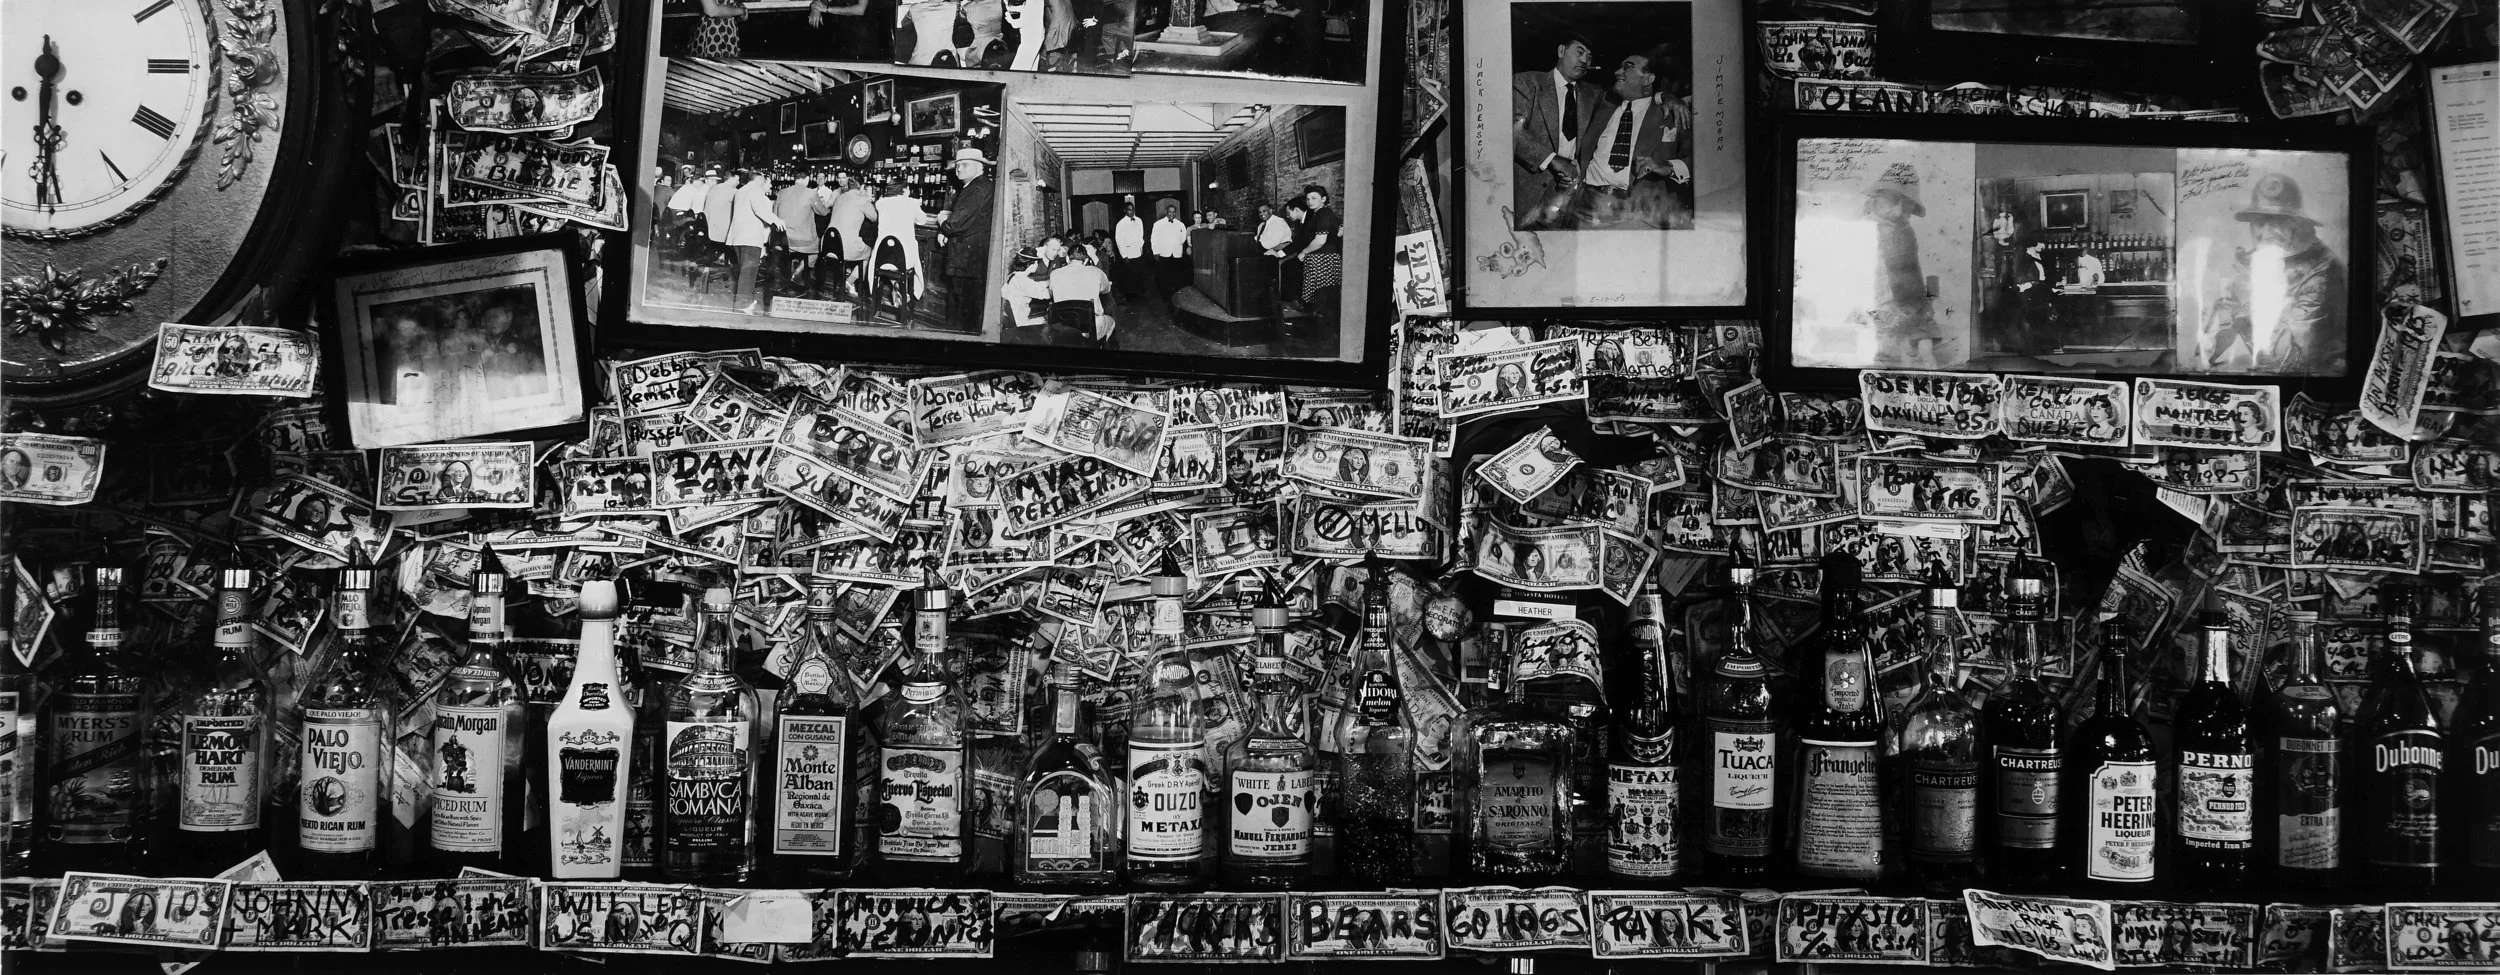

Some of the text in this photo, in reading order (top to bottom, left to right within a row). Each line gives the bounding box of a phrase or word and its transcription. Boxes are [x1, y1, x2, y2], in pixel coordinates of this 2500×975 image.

[1769, 27, 1808, 50] JOHN
[2030, 408, 2080, 422] CANADA
[1518, 605, 1553, 617] HEATHER
[471, 616, 491, 627] Morgan
[87, 632, 122, 641] ONE LITER
[222, 625, 243, 636] RUM
[483, 669, 500, 678] RUM
[1359, 685, 1399, 700] MIDORI
[1831, 688, 1860, 698] Imported
[1365, 698, 1392, 708] melon
[58, 716, 131, 730] MYERS'S
[196, 719, 245, 728] IMPORTED
[455, 714, 497, 735] Morgan
[789, 723, 836, 734] MEZCAL
[71, 730, 114, 744] RUM
[190, 734, 250, 750] LEMON
[308, 728, 349, 753] PALO
[804, 734, 835, 742] GUSANO
[2286, 739, 2325, 751] DUBONNET
[195, 750, 246, 766] HART
[312, 747, 366, 776] VIEJO.
[1718, 749, 1774, 770] TUACA
[2000, 757, 2062, 770] CHARTREUS
[2182, 750, 2254, 768] PERNO
[2375, 740, 2443, 773] Dubonne
[564, 757, 614, 773] VANDERMINT
[783, 757, 836, 775] Monte
[1810, 751, 1878, 778] Frangelic
[201, 771, 236, 784] RUM
[903, 770, 928, 779] Tequila
[1727, 772, 1769, 780] LIQUEUR
[1914, 774, 1978, 787] CHARTREUS
[783, 774, 834, 791] Alban
[1147, 779, 1184, 789] Greek DRY
[787, 791, 831, 801] Regional de
[882, 778, 953, 803] Cuervo Especial
[1494, 785, 1544, 798] AMARETTO
[460, 800, 487, 813] RUM
[669, 798, 742, 816] ROMANA
[793, 801, 823, 811] Oaxaca
[1154, 792, 1197, 812] OUZO
[1256, 793, 1303, 808] OJEN
[2113, 795, 2153, 813] PETER
[2208, 801, 2234, 811] PERNOD
[320, 820, 366, 831] RICAN RUM
[2300, 815, 2324, 827] EXTRA
[1234, 829, 1264, 843] MANUEL
[2115, 829, 2152, 839] LIQUEUR
[1262, 843, 1297, 852] JEREZ
[2186, 837, 2240, 849] Imported from
[233, 890, 368, 926] JOHNNY
[560, 891, 627, 914] WILL
[1797, 902, 1916, 928] PHYSIO
[256, 914, 356, 944] MARK
[1302, 899, 1434, 949] BEARS
[1450, 905, 1492, 940] GO
[550, 919, 595, 944] US
